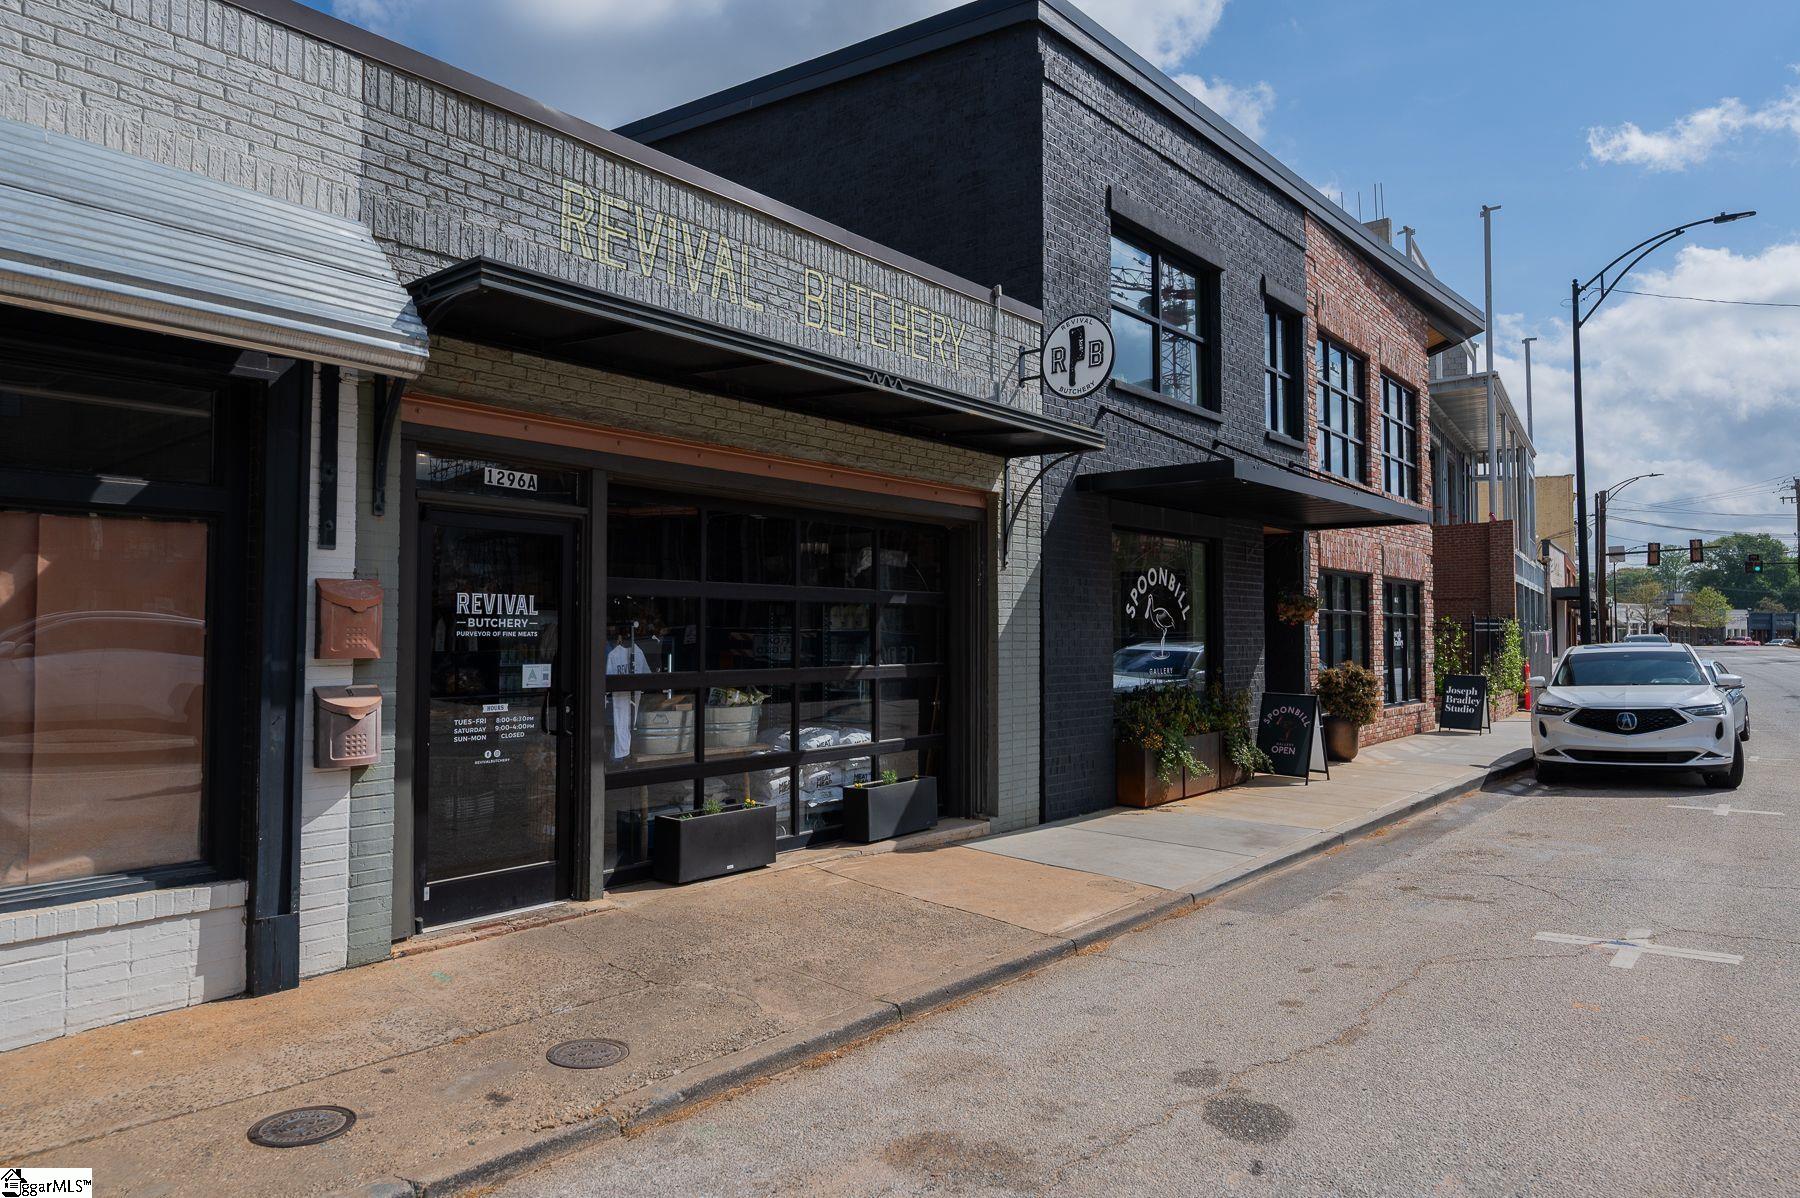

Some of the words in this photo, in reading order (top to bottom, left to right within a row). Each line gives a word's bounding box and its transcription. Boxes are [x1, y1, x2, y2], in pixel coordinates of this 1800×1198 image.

[560, 178, 764, 312] REVIVAL
[803, 266, 967, 370] BUTCHERY
[1060, 317, 1094, 331] REVIVAL
[1051, 346, 1067, 374] R
[1088, 339, 1104, 368] B
[1059, 380, 1096, 395] BUTCHERY
[487, 469, 536, 490] 1296A
[1125, 567, 1190, 620] SPOONBILL
[456, 592, 539, 615] REVIVAL
[467, 618, 529, 628] BUTCHERY
[1445, 686, 1478, 696] Joseph
[1445, 695, 1480, 706] Bradley
[1444, 703, 1475, 713] Studio
[454, 718, 487, 726] TUES-FRI
[1263, 706, 1310, 727] SPOONBILL
[454, 735, 487, 743] SUN-MON
[501, 731, 525, 739] CLOSED
[1271, 745, 1296, 755] OPEN
